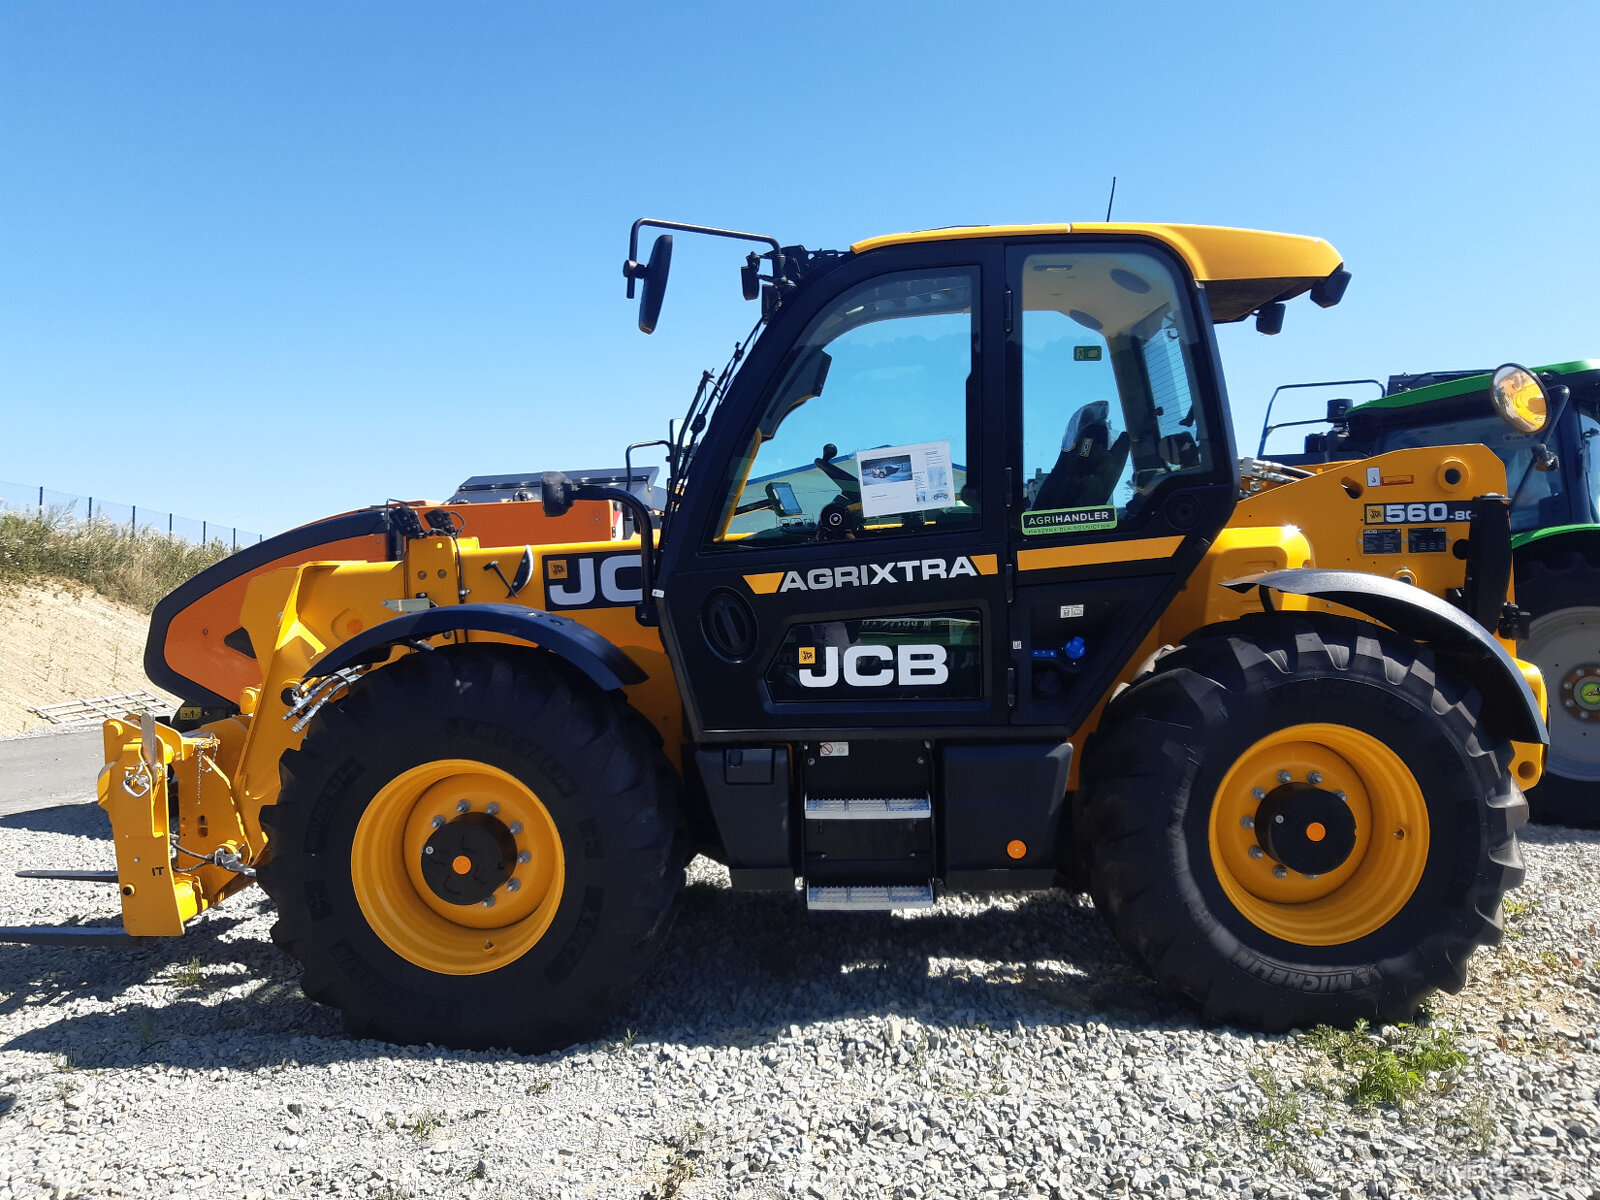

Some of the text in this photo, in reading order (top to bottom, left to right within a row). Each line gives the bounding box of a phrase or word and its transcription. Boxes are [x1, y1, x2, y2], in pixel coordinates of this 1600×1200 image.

[1028, 511, 1109, 526] AGRIHANDLER
[549, 555, 643, 605] JC
[779, 556, 978, 593] AGRIXTRA
[799, 645, 949, 688] JCB
[1231, 951, 1353, 993] MICHELIN
